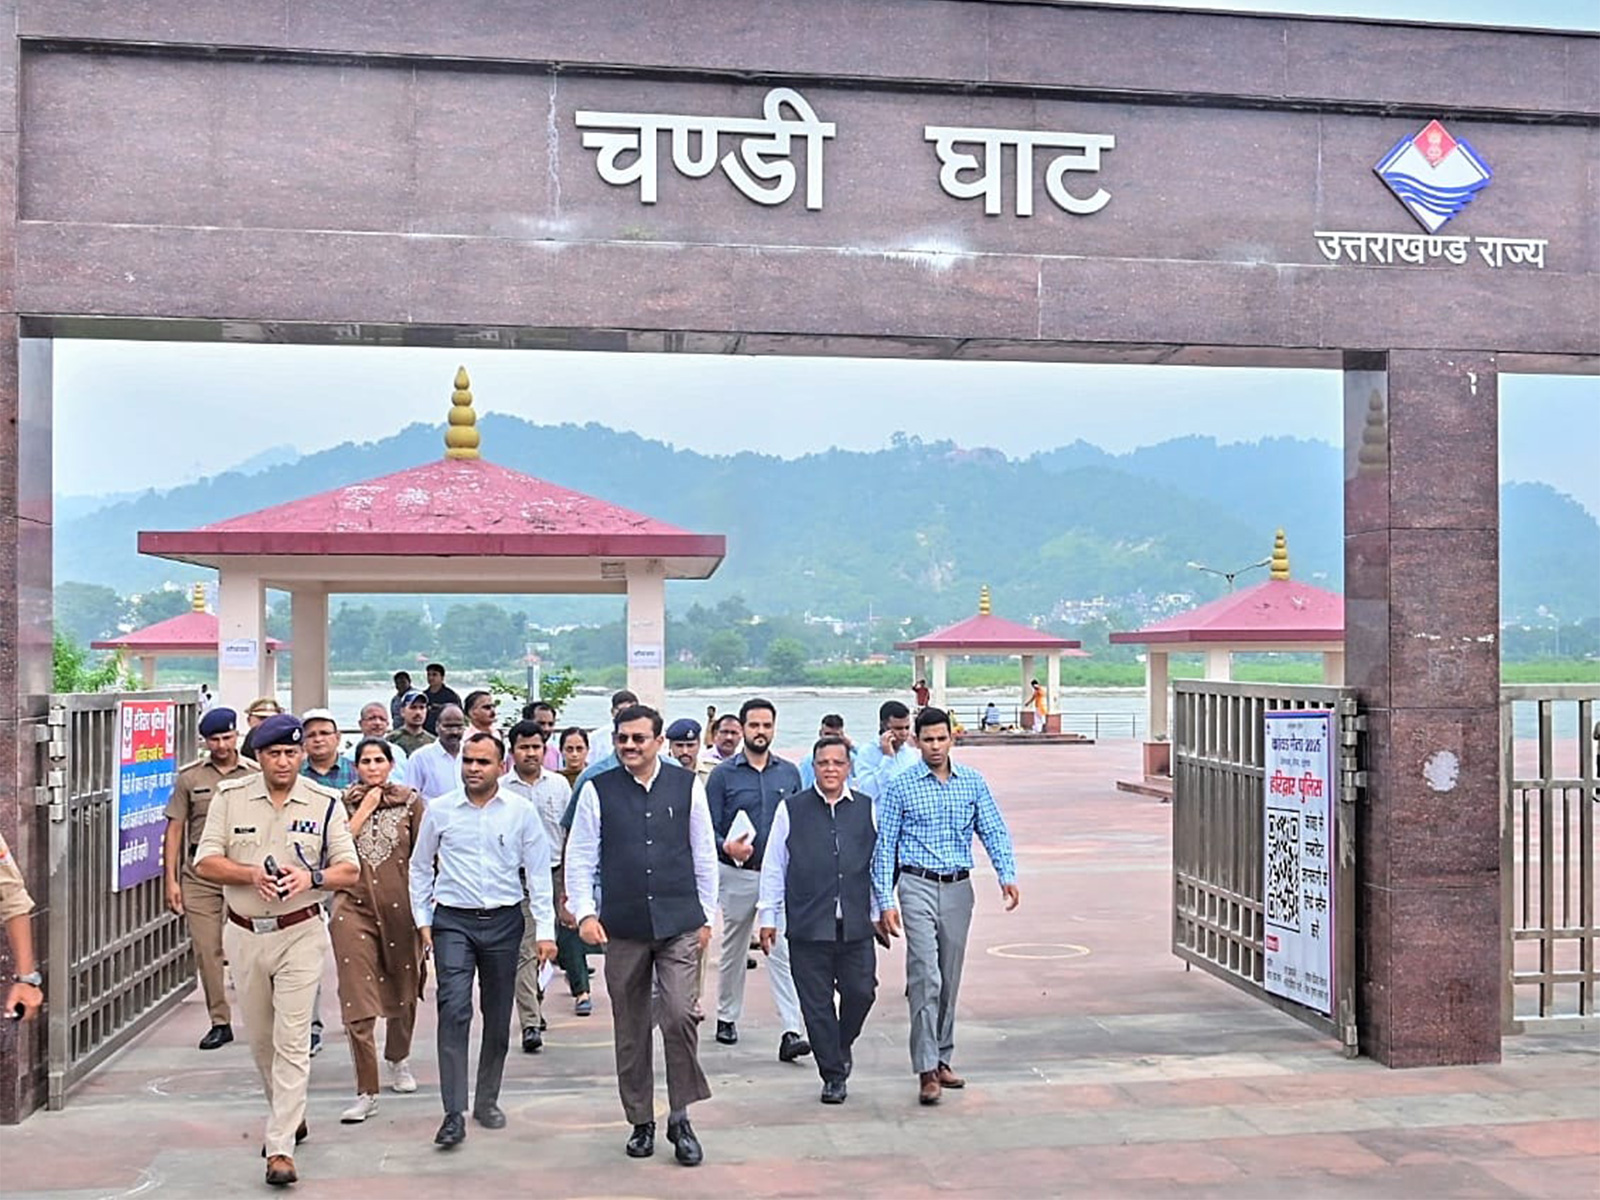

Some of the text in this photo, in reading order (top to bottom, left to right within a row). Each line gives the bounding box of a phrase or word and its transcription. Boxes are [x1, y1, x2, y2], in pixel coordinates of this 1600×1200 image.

[575, 87, 1115, 216] चण्डी घाट
[1313, 230, 1549, 269] उत्तराखण्ड राज्य
[1270, 770, 1323, 804] हरिद्वार पुलिस
